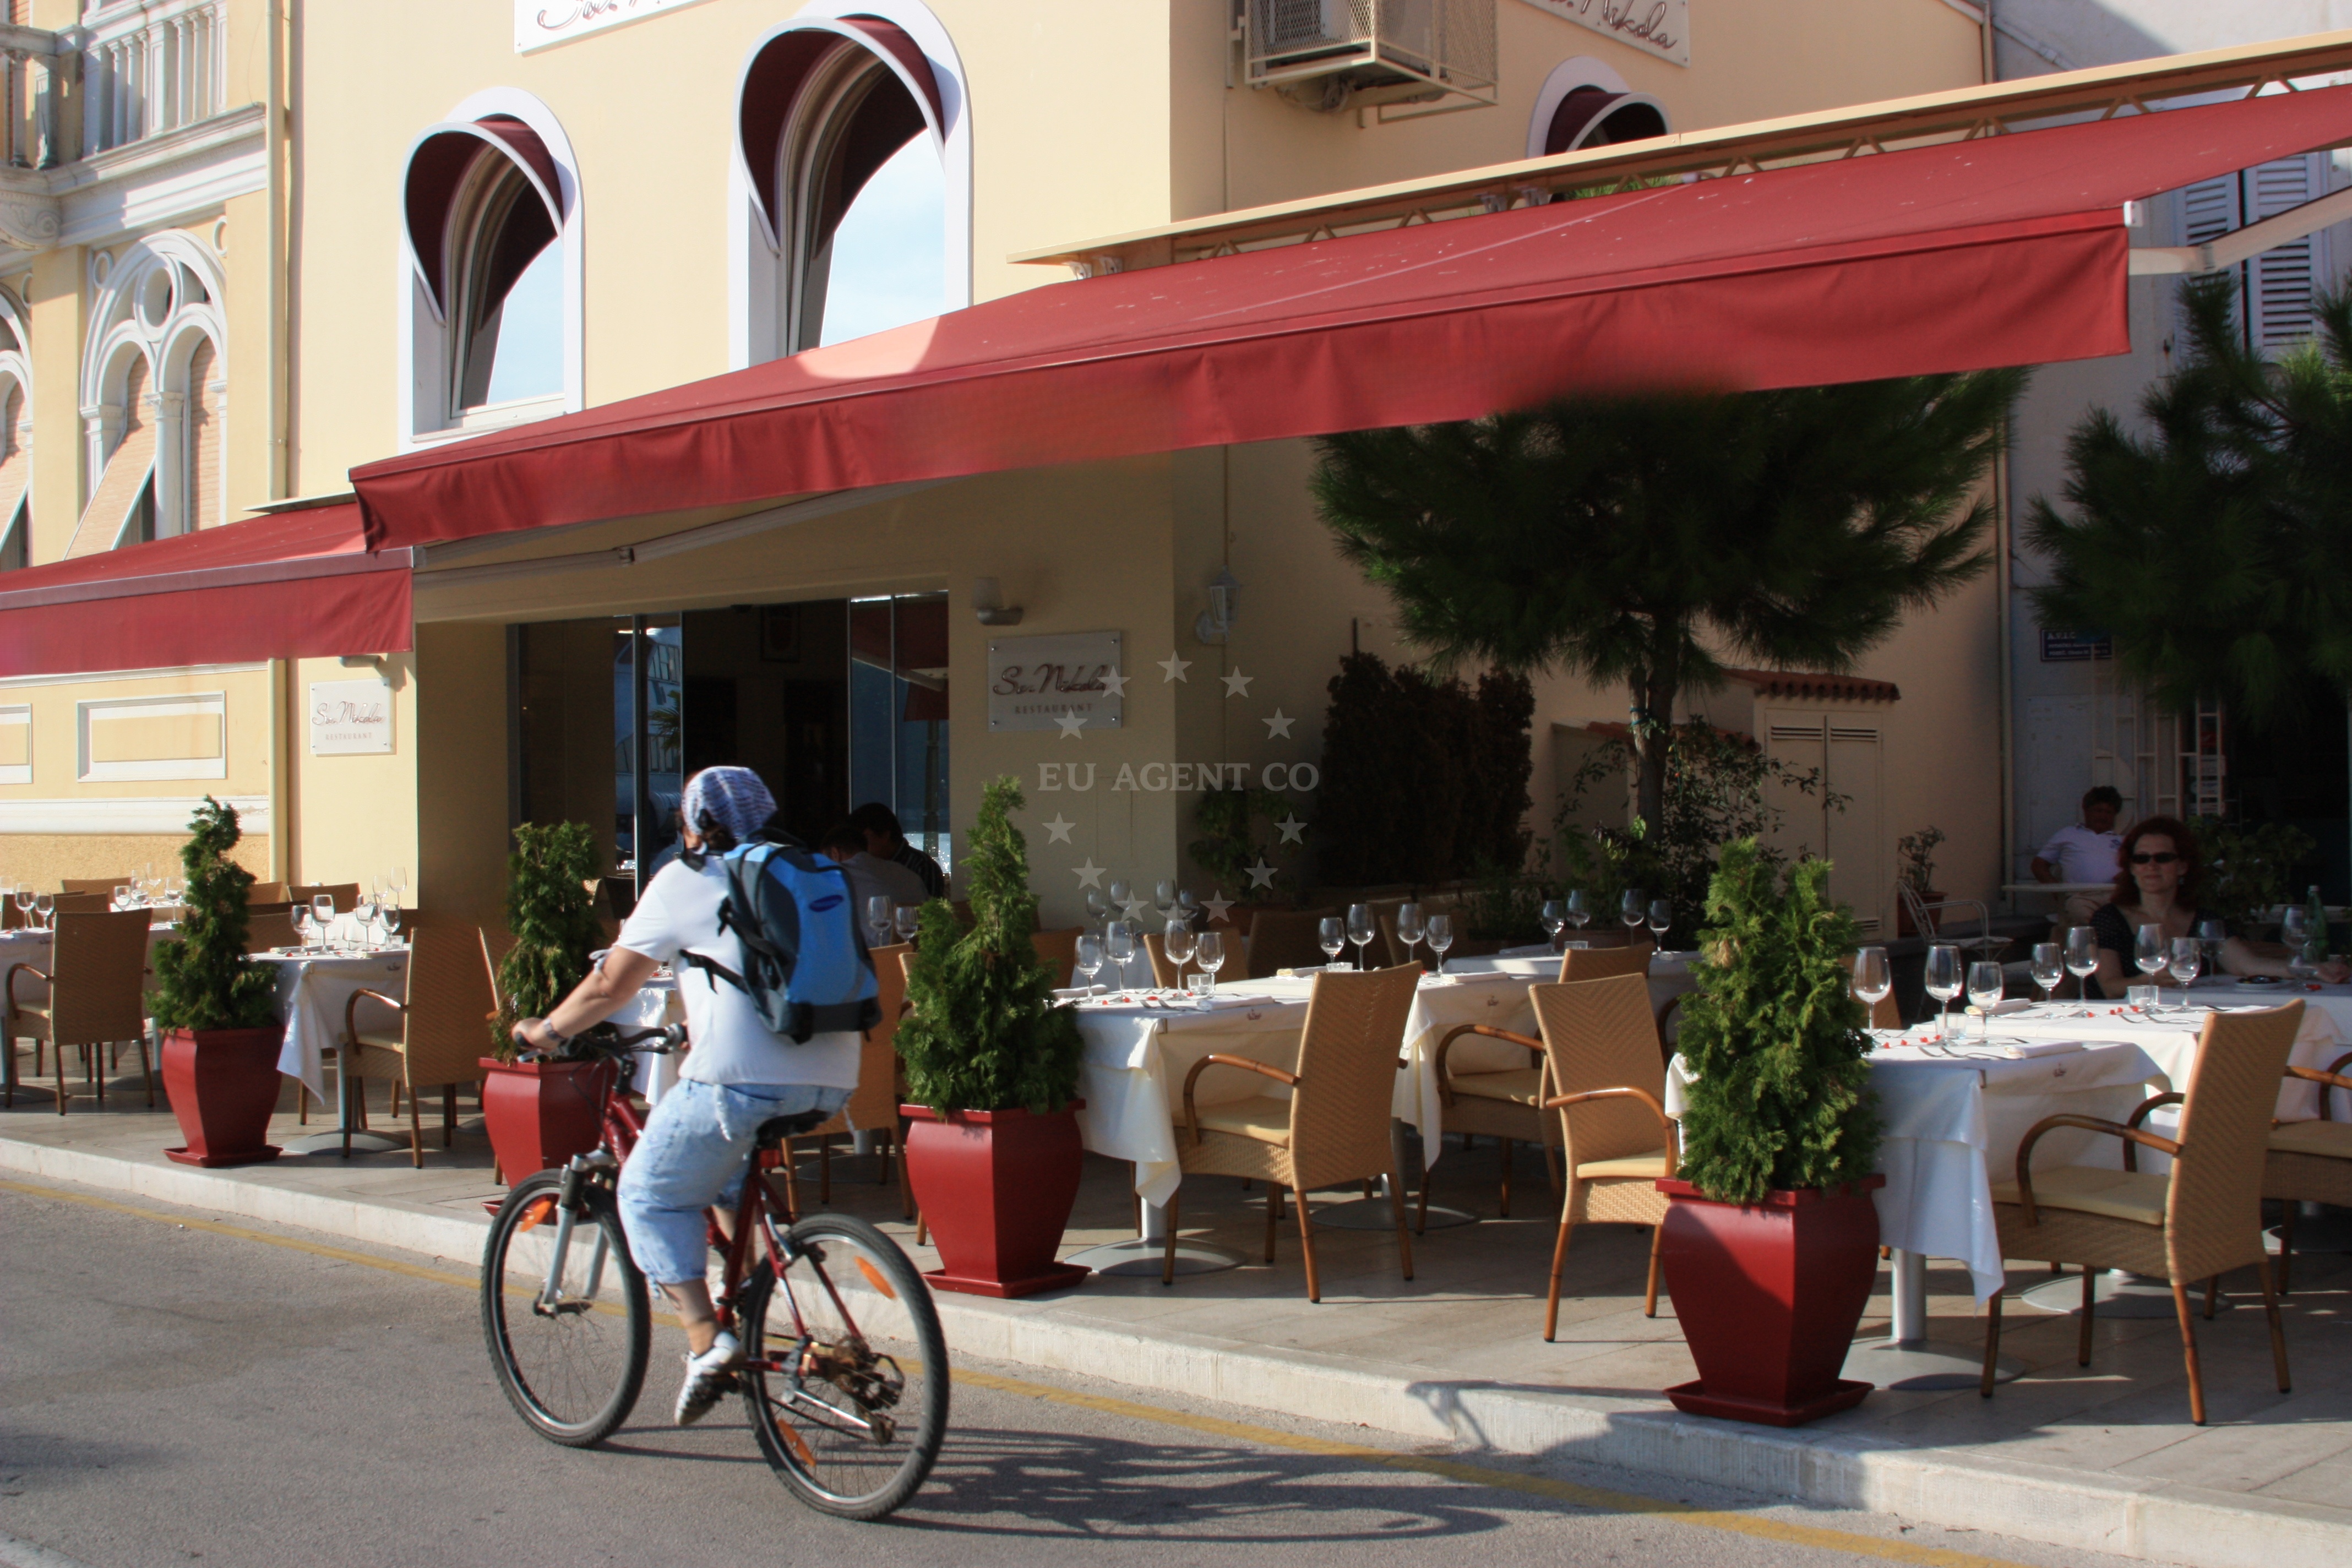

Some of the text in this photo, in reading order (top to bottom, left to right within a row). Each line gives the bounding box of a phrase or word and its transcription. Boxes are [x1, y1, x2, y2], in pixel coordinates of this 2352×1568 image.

[336, 701, 386, 724] Nikola
[1015, 703, 1092, 714] RESTAURANT
[325, 732, 372, 741] RESTAURANT
